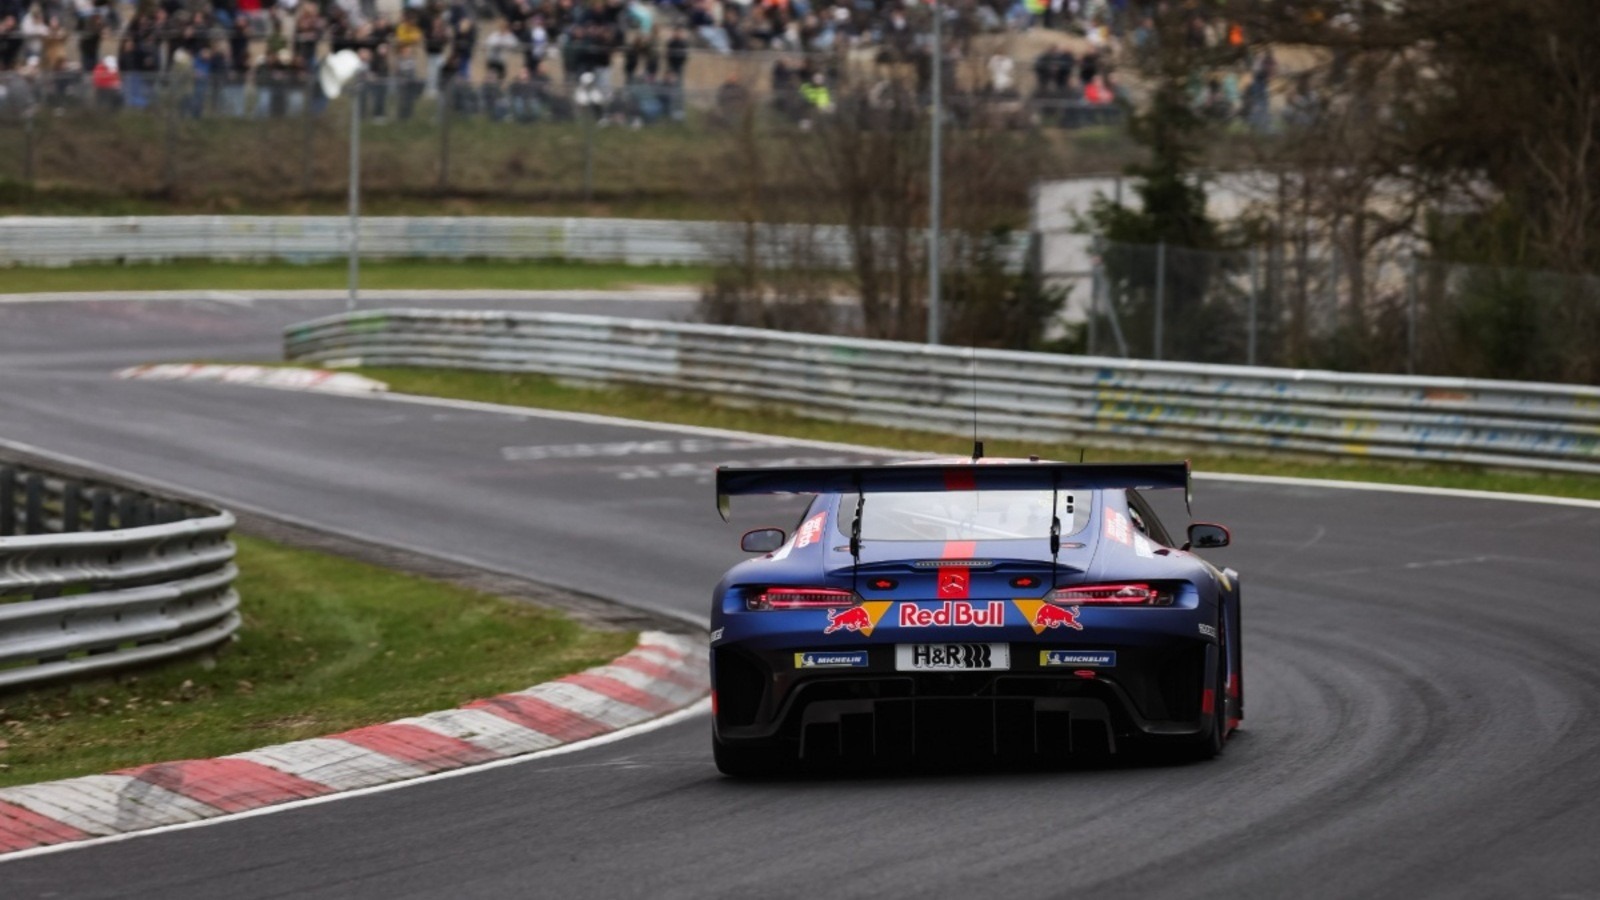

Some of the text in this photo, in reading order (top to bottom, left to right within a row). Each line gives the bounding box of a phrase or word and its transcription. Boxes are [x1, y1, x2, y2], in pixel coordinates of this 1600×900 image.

[900, 601, 1004, 626] Red Bull
[817, 656, 862, 664] MICHELIN
[912, 644, 962, 667] H&R
